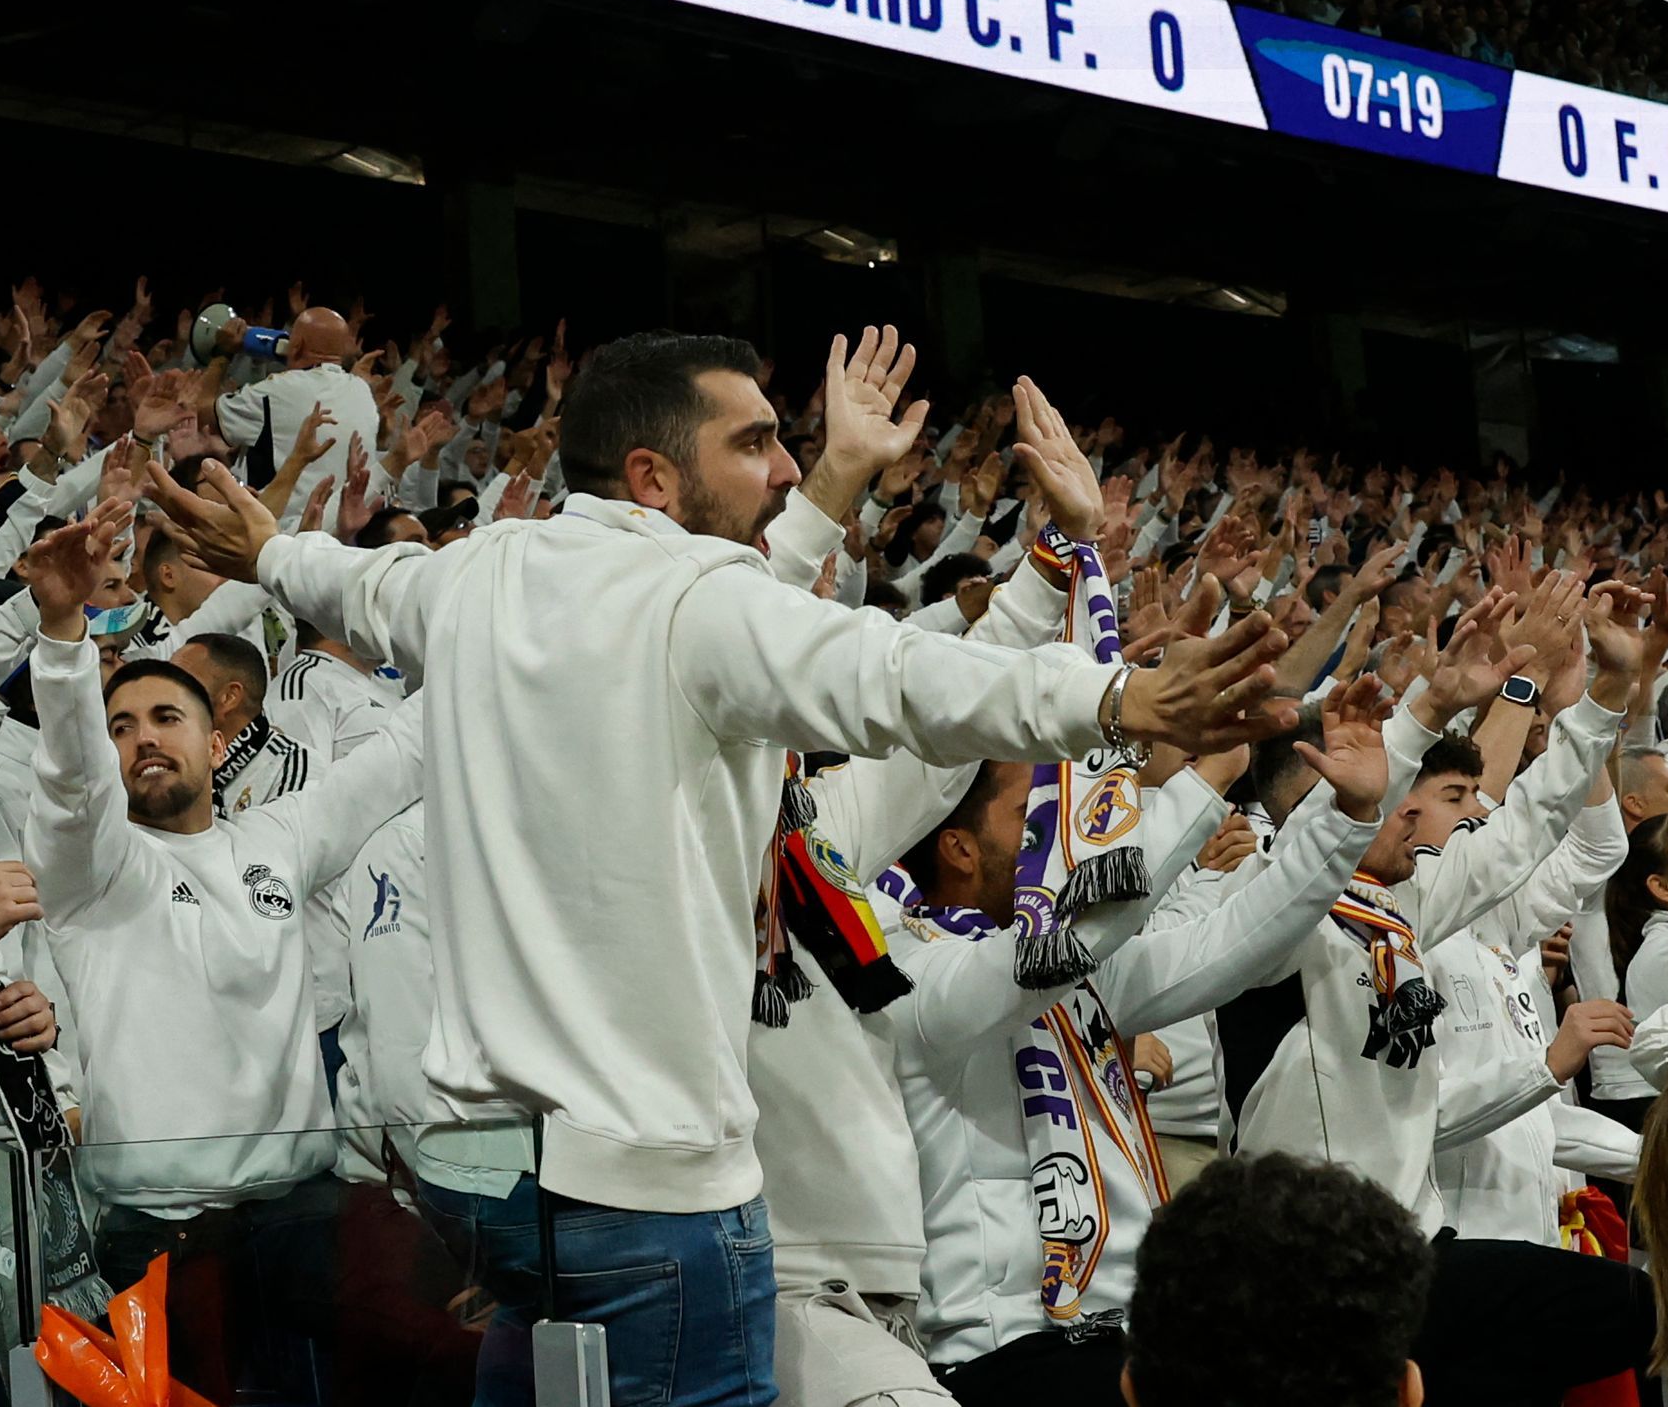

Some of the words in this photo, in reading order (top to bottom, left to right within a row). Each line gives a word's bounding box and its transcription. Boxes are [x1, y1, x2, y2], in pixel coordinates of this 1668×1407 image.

[1149, 8, 1185, 92] 0
[1321, 52, 1444, 141] 07:19
[1559, 104, 1588, 178] 0
[1018, 894, 1043, 911] REAL
